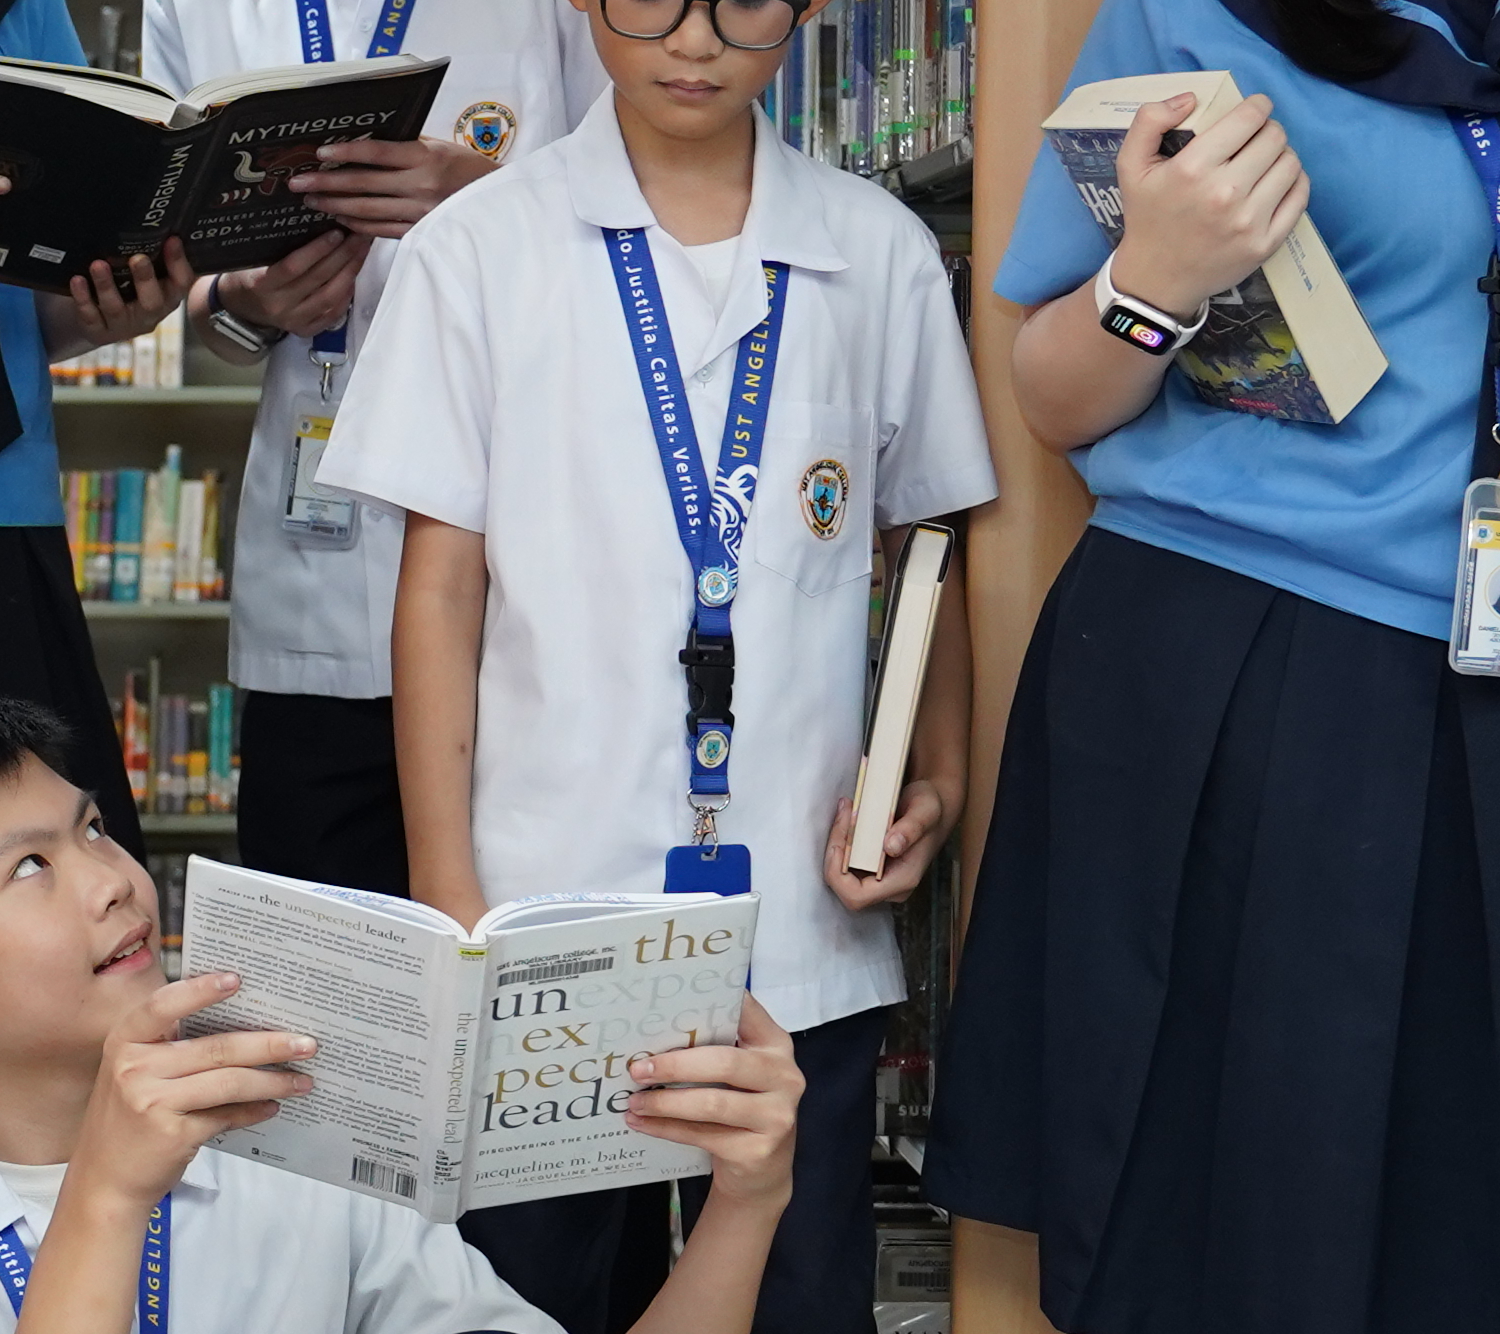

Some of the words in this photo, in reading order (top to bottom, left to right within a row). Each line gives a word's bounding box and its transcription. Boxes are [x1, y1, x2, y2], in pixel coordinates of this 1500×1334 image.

[306, 8, 324, 63] Carita
[228, 110, 397, 145] MYTHOLOGY
[141, 143, 193, 227] MYTHOLOGY
[190, 223, 243, 241] GODS
[197, 210, 254, 226] TIMELESS
[260, 205, 295, 216] TALES
[221, 236, 251, 247] EDITH
[255, 228, 309, 242] HAMILTON
[625, 266, 657, 353] Justitia.
[650, 357, 680, 444] Caritas.
[672, 447, 702, 536] Veritas.
[731, 414, 755, 459] UST
[259, 893, 281, 909] the
[284, 901, 362, 933] unexpected
[365, 922, 407, 945] leader
[635, 919, 732, 964] the
[490, 987, 571, 1021] un
[456, 1012, 478, 1035] the
[522, 1022, 591, 1054] ex
[447, 1035, 472, 1115] unexpected
[479, 1077, 648, 1134] leade
[479, 1140, 556, 1157] DISCOVERING
[561, 1135, 582, 1145] THE
[587, 1129, 630, 1142] LEADER
[474, 1158, 565, 1183] jacqueline
[571, 1157, 592, 1168] m.
[597, 1148, 646, 1164] baker
[514, 1169, 586, 1184] JACQUELINE
[604, 1161, 644, 1172] WELCH
